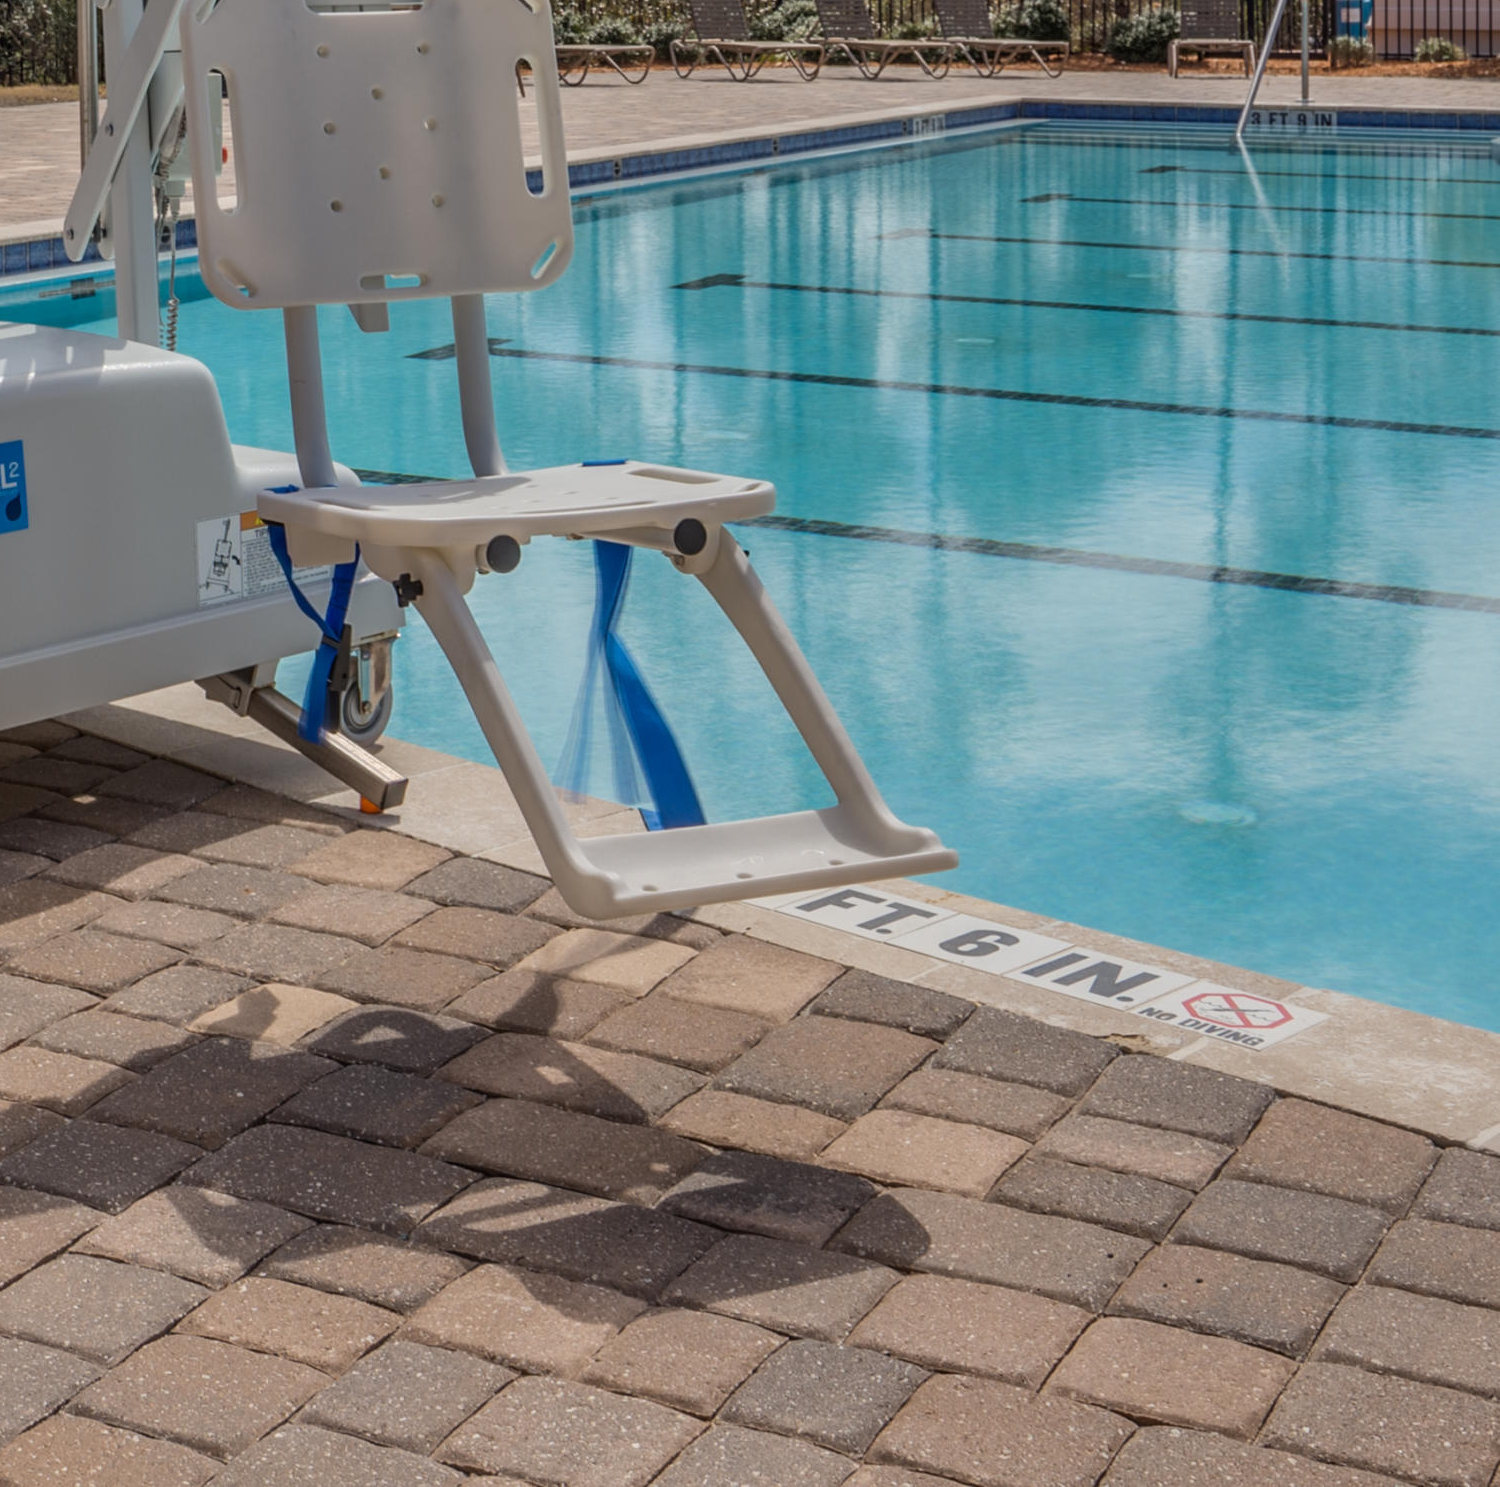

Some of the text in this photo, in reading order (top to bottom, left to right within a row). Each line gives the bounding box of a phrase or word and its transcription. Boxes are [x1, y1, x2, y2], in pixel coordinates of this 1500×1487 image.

[1251, 112, 1261, 125] 3
[1269, 113, 1288, 126] FT
[1315, 114, 1332, 126] IN
[795, 889, 1161, 1002] FT. 6 IN.
[1138, 1007, 1265, 1046] NO DIVING
